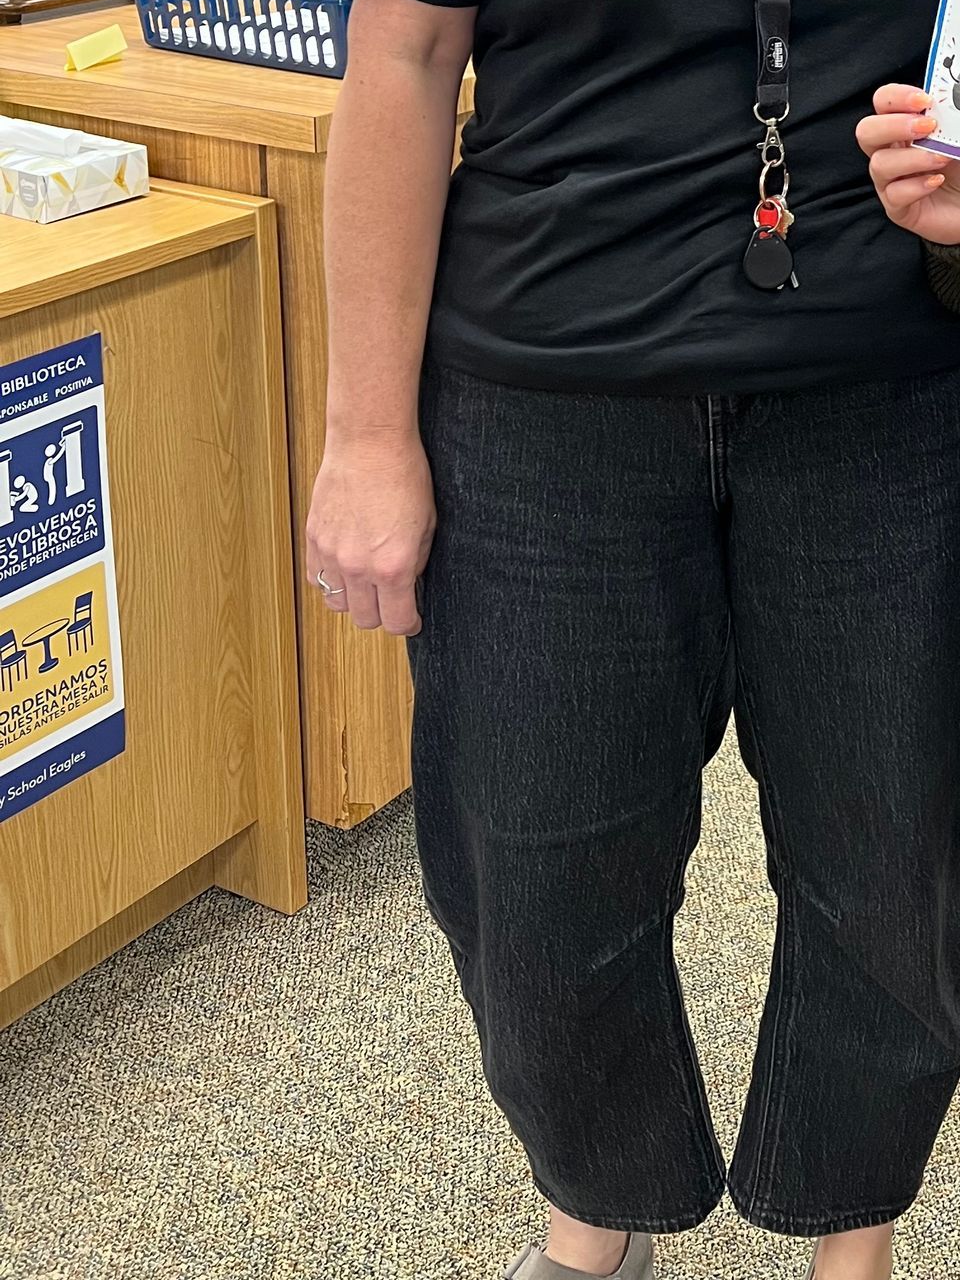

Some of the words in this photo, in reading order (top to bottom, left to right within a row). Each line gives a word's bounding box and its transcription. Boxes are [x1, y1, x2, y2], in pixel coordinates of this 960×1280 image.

[0, 393, 48, 419] PONSABLE
[55, 376, 93, 397] POSITIVA
[1, 355, 86, 396] BIBLIOTECA
[0, 499, 96, 554] EVOLVEMOS
[22, 520, 82, 559] LIBROS
[85, 514, 98, 530] A
[29, 527, 98, 567] PERTENECEN
[0, 658, 107, 725] ORDENAMOS
[0, 700, 59, 737] NUESTRA
[62, 679, 97, 705] MESA
[100, 672, 107, 684] Y
[0, 726, 32, 749] SILLAS
[34, 708, 66, 729] ANTES
[67, 701, 81, 712] DE
[82, 684, 109, 704] SALIR
[7, 768, 47, 801] School
[50, 750, 86, 777] Eagles
